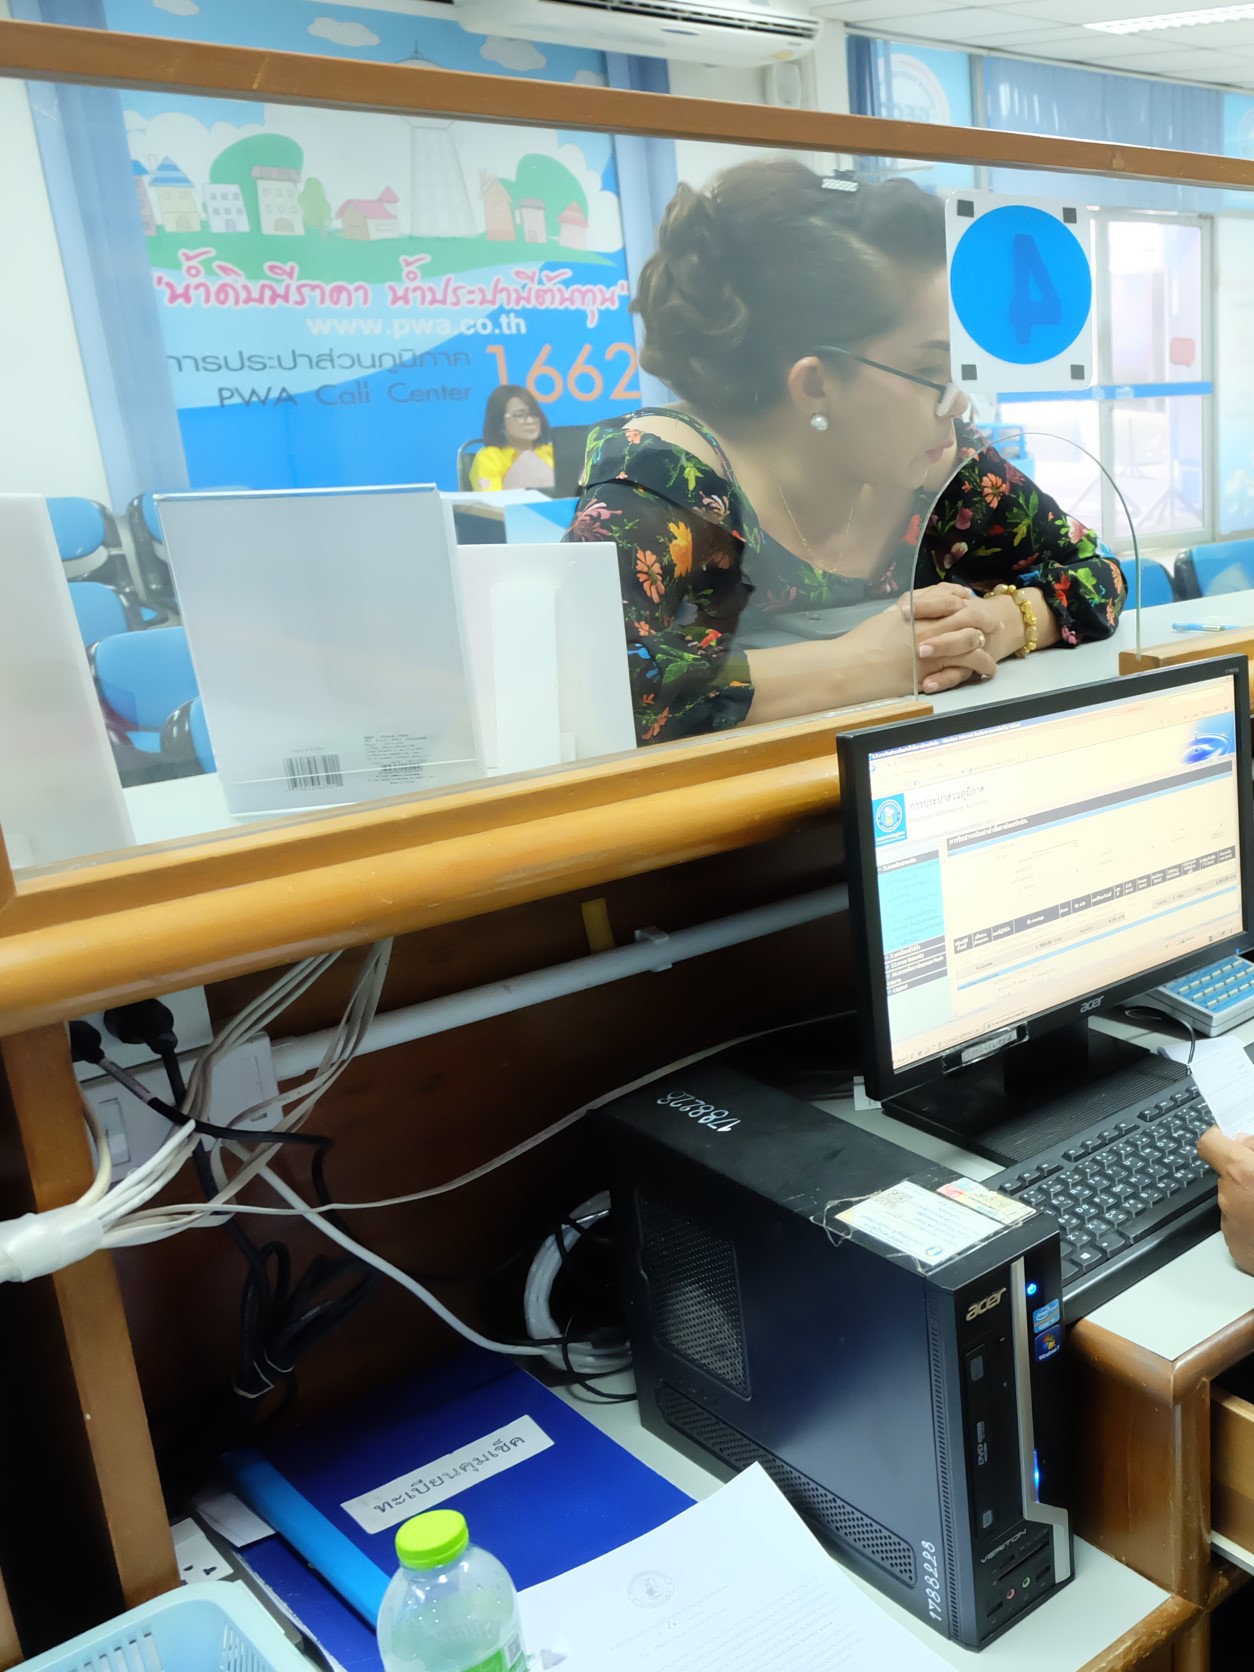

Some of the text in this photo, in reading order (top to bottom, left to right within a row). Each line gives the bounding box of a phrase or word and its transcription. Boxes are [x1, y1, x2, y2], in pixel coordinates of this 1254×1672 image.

[306, 313, 527, 340] www.pwa.co.th
[486, 343, 640, 403] 1662
[217, 385, 297, 408] PWA
[387, 381, 473, 404] Center
[1080, 995, 1105, 1013] acer
[966, 1287, 1007, 1322] acer
[373, 1435, 526, 1514] ทะเบียนคุมเช็ค
[980, 1528, 1027, 1563] VERITON
[921, 1540, 942, 1621] 1788228
